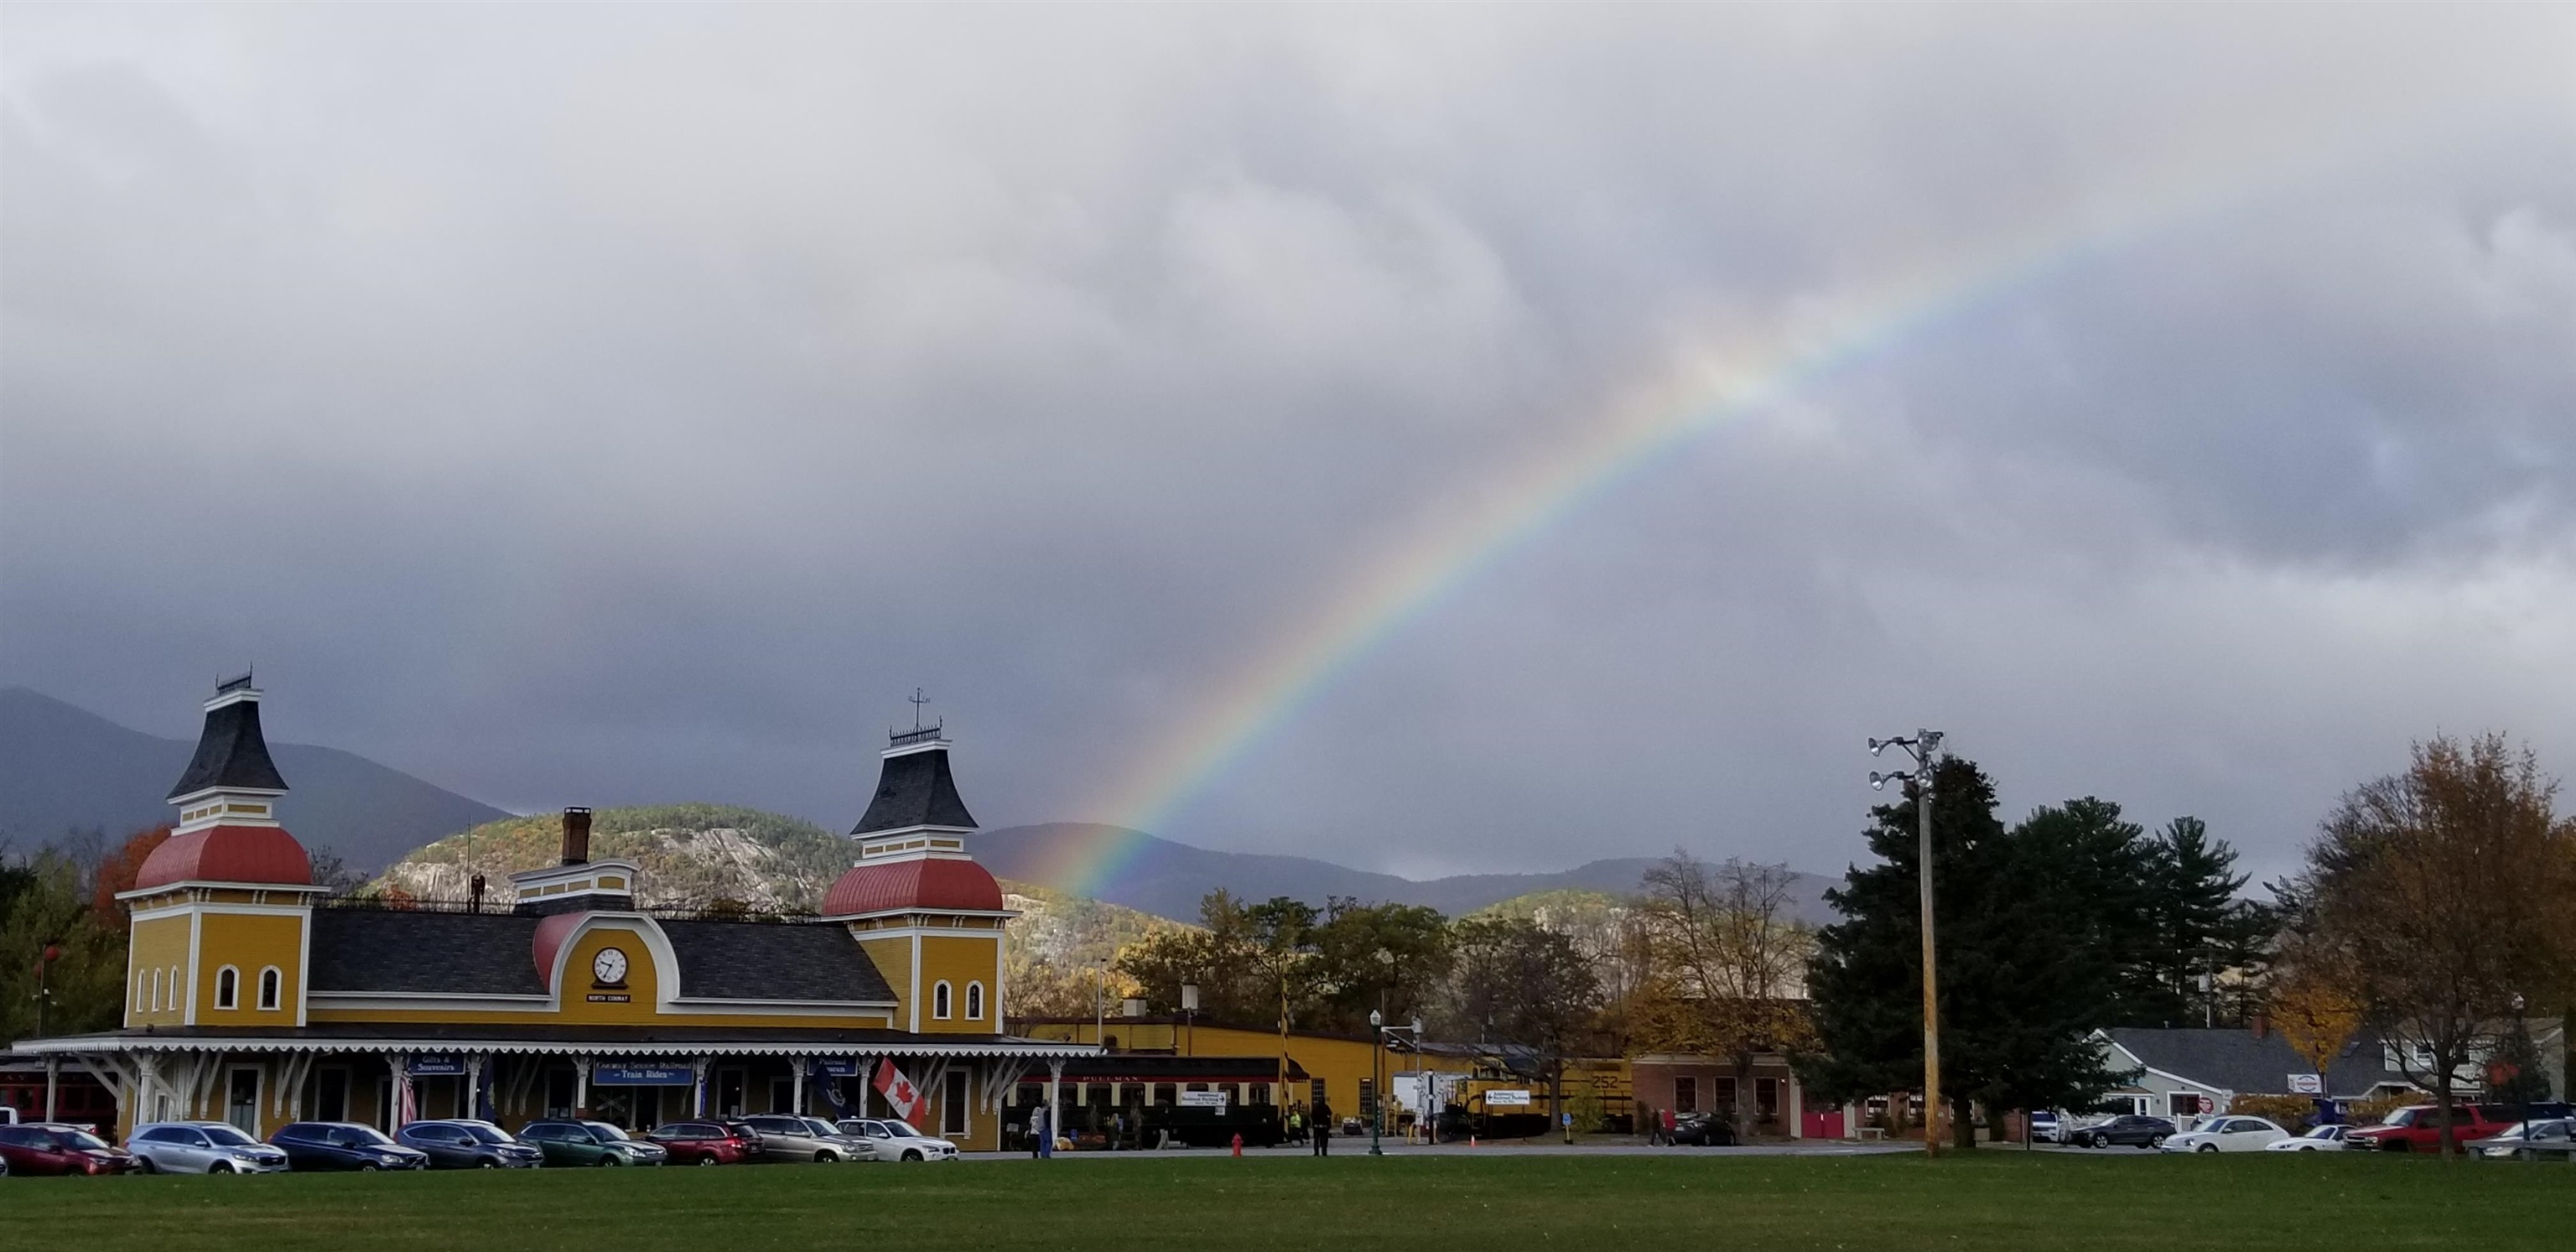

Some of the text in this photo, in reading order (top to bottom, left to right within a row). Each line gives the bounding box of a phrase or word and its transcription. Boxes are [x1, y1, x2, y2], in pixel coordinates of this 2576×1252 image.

[659, 1061, 692, 1069] Railroad
[621, 1070, 667, 1078] Train Rides
[1592, 1076, 1618, 1088] 252
